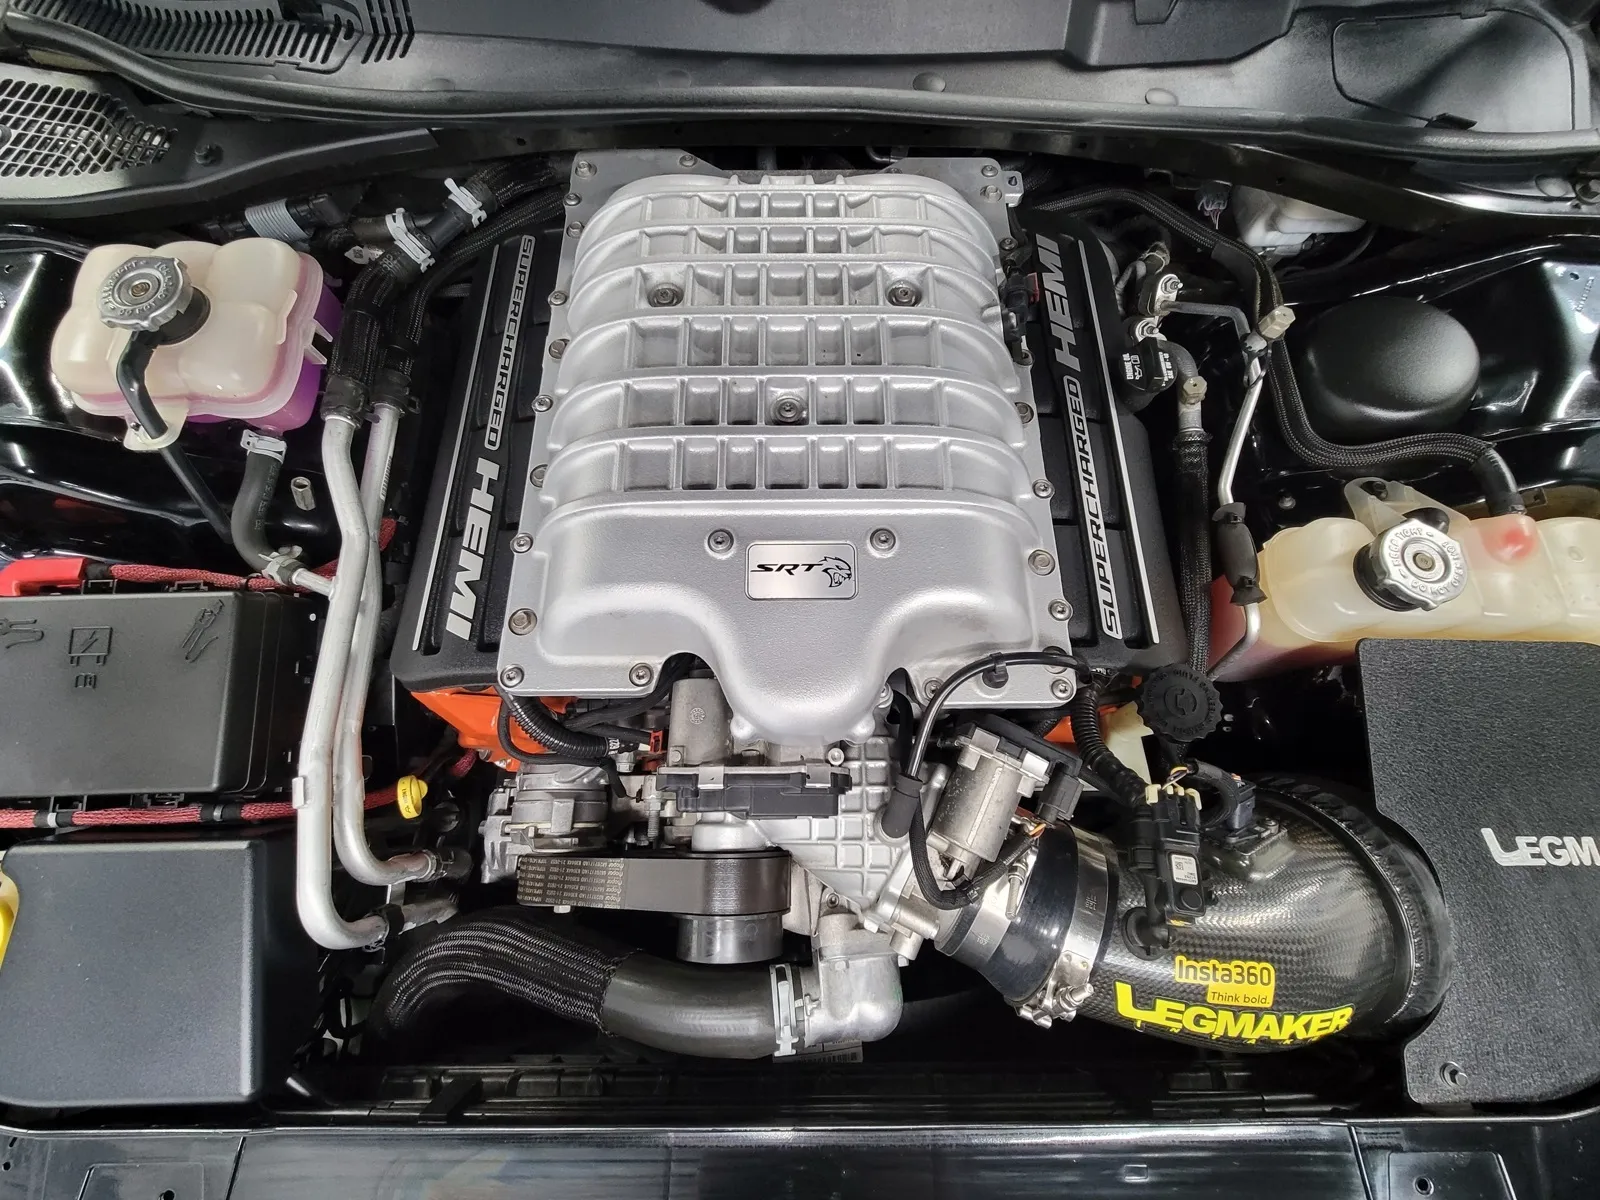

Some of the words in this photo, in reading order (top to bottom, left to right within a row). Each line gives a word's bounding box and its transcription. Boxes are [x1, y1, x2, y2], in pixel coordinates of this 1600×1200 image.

[485, 236, 535, 449] SUPERCHARGED
[1036, 234, 1081, 372] HEMI
[446, 457, 500, 640] HEMI
[1065, 376, 1121, 639] SUPERCHARGED
[750, 563, 824, 576] SRT
[1114, 981, 1354, 1040] LEGMAKER
[1178, 959, 1272, 987] Insta360
[1211, 991, 1241, 1003] Think
[1243, 993, 1270, 1005] bold.
